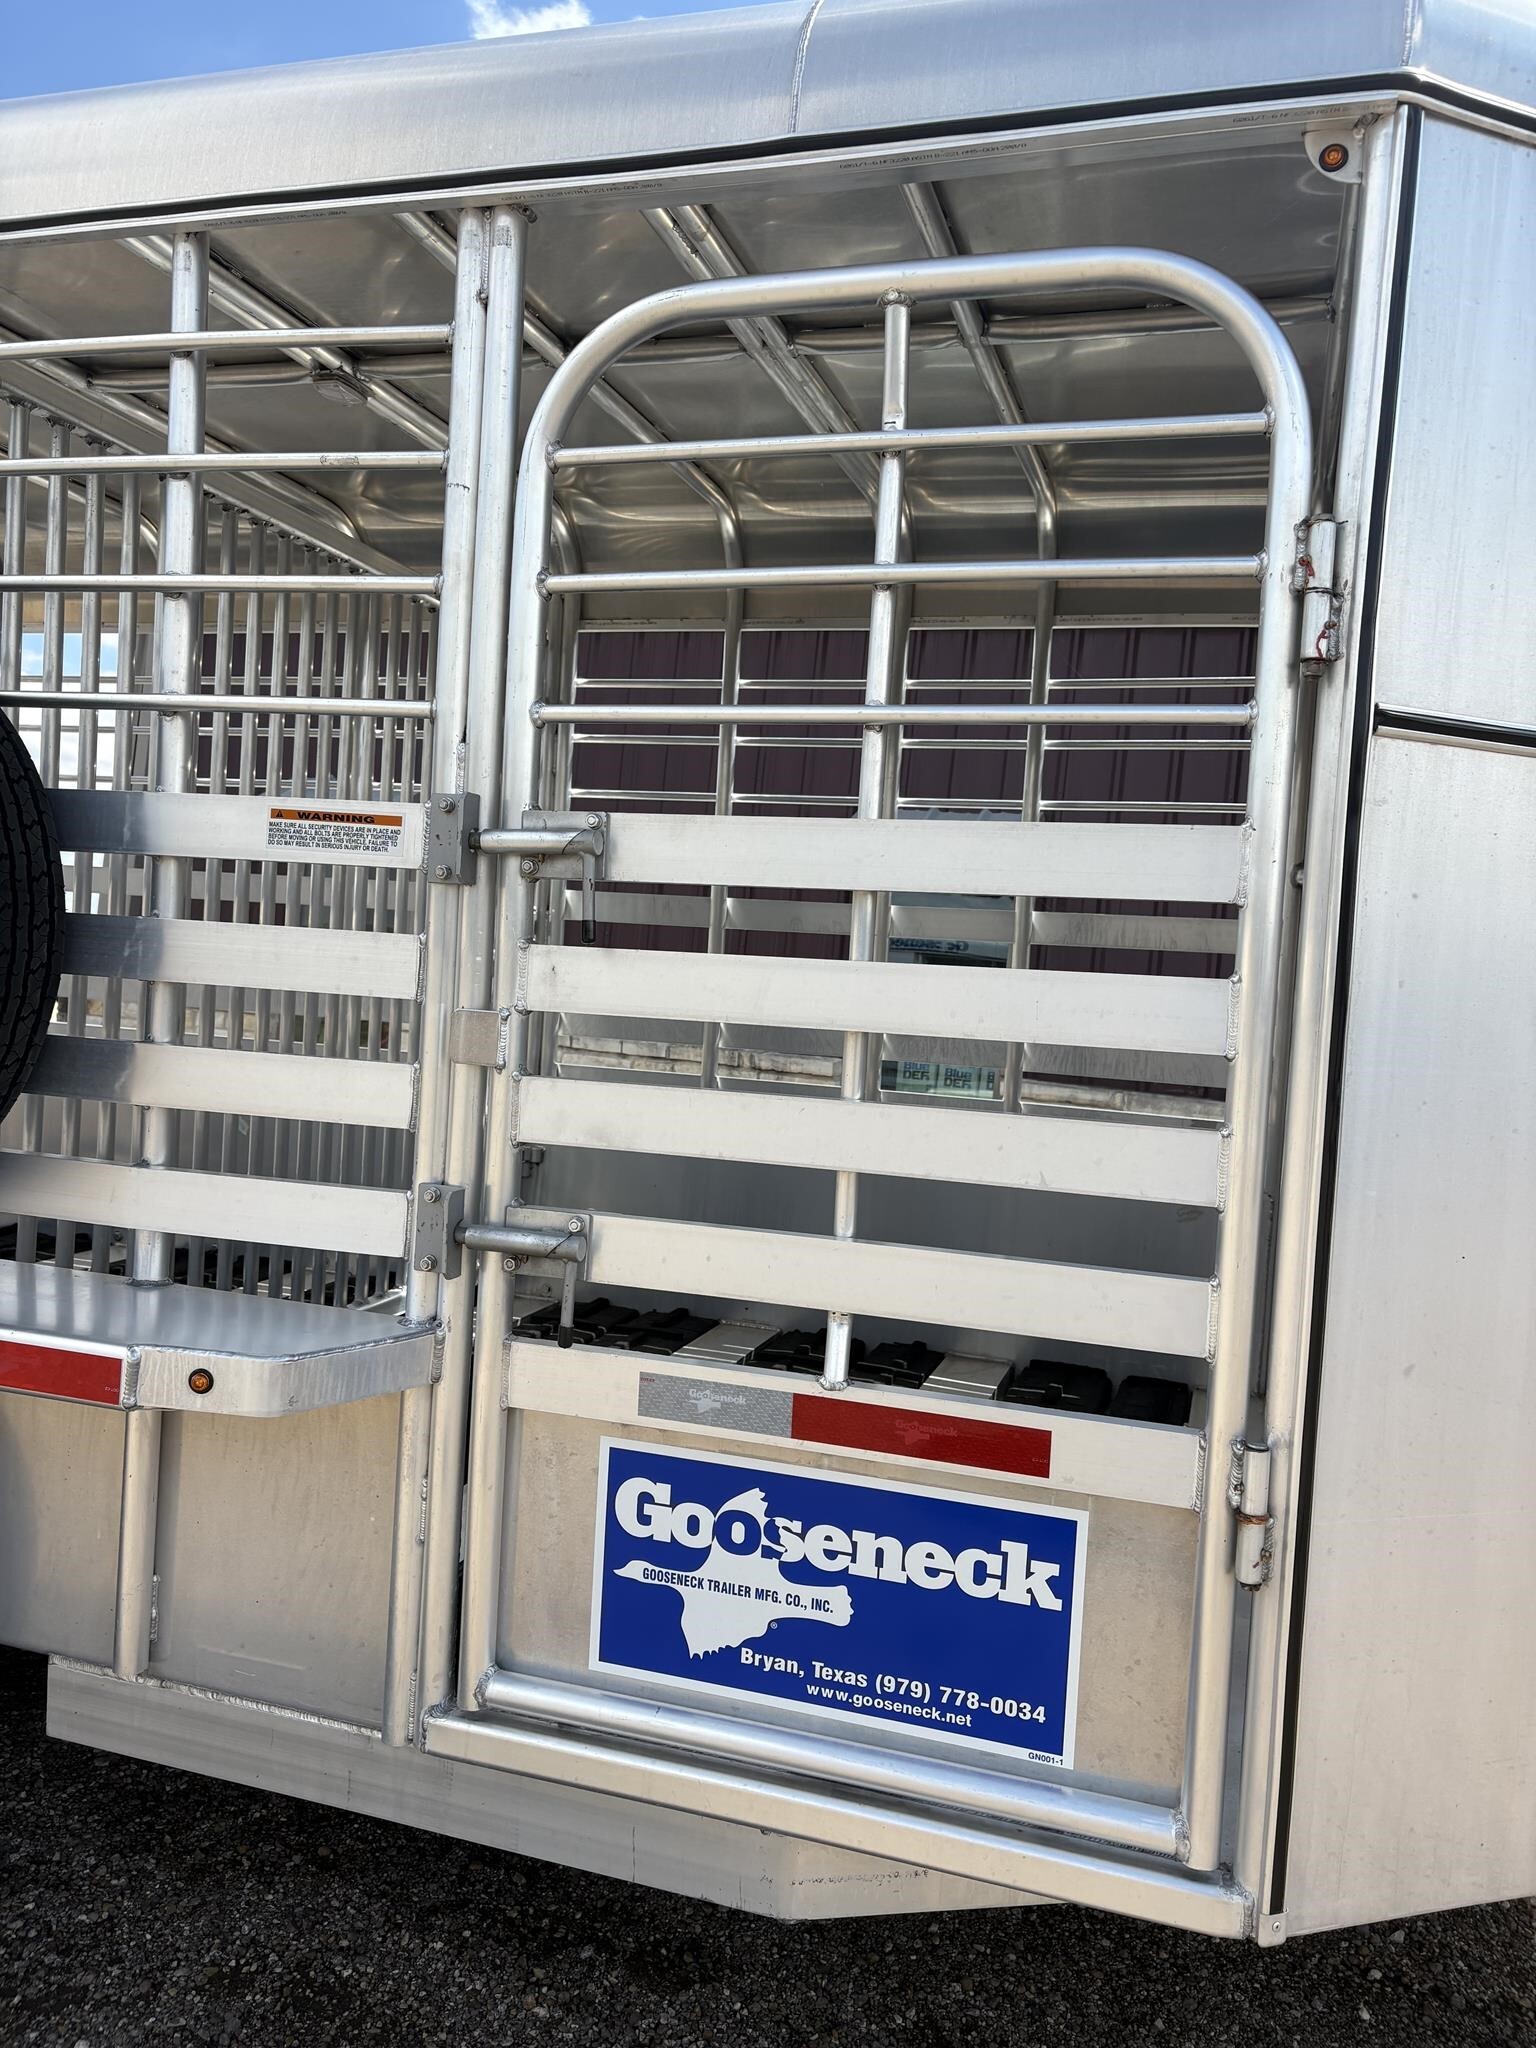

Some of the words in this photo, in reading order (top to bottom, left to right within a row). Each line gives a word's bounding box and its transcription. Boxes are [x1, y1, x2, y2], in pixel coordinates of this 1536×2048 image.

[298, 812, 376, 823] WARNING
[945, 1068, 972, 1079] Blue
[614, 1477, 1064, 1611] Gooseneck
[642, 1567, 704, 1590] GOOSENECK
[707, 1579, 751, 1598] TRAILER
[754, 1586, 782, 1605] MFG.
[786, 1591, 808, 1611] CO.,
[811, 1597, 833, 1614] INC.
[740, 1648, 804, 1678] Bryan,
[811, 1661, 868, 1688] Texas
[875, 1673, 931, 1704] (979)
[939, 1686, 1047, 1724] 778-0034
[807, 1684, 972, 1727] www.gooseneck.net
[1028, 1752, 1064, 1766] GN001-1
